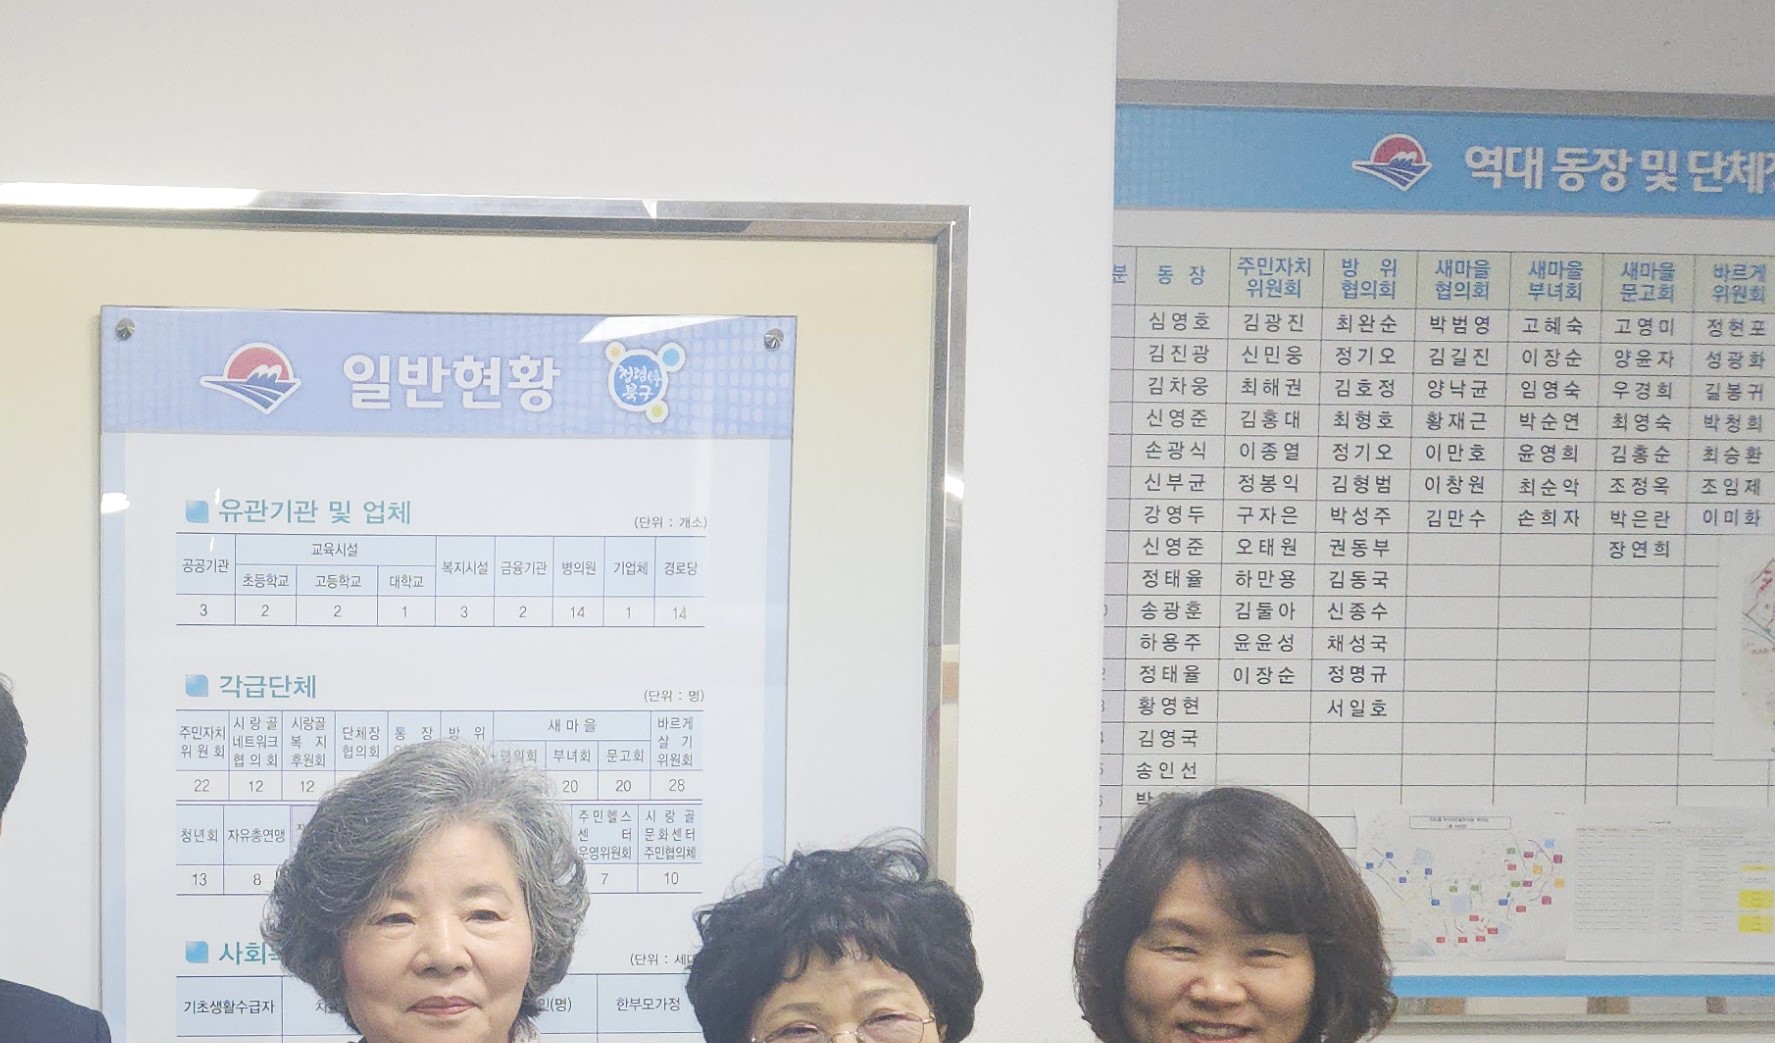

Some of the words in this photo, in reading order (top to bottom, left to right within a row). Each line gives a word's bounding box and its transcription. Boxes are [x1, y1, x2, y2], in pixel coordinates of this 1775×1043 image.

[1464, 145, 1543, 190] 역대
[1551, 147, 1633, 192] 동장
[1640, 149, 1678, 192] 및
[1688, 150, 1775, 194] 단체
[1237, 256, 1312, 277] 주민자치
[1434, 259, 1491, 279] 새마을
[1527, 260, 1584, 280] 새마을
[1620, 261, 1675, 282] 새마을
[1713, 263, 1767, 283] 바르게
[1246, 279, 1302, 299] 위원회
[1341, 280, 1397, 300] 협의회
[1434, 280, 1490, 301] 협의회
[1528, 281, 1583, 301] 부녀회
[1620, 283, 1675, 303] 문고회
[1712, 284, 1767, 304] 위원회
[342, 354, 562, 412] 일반현황
[218, 499, 319, 525] 유관기관
[328, 499, 352, 525] 및
[363, 499, 412, 525] 업체
[312, 542, 359, 557] 교육시설
[182, 558, 230, 574] 공공기관
[441, 560, 489, 576] 복지시설
[500, 560, 548, 576] 금융기관
[561, 560, 597, 576] 병의원
[613, 561, 649, 576] 기업체
[664, 561, 699, 576] 경로당
[242, 573, 290, 588] 초등학교
[315, 573, 362, 589] 고등학교
[389, 575, 425, 589] 대학교
[570, 606, 586, 619] 14
[219, 674, 317, 699] 각급단체
[657, 715, 695, 730] 바르게
[179, 725, 226, 741] 주민자치
[342, 726, 381, 741] 단체장
[232, 735, 279, 749] 네트워크
[342, 744, 381, 760] 협의회
[553, 748, 592, 763] 부녀회
[606, 748, 645, 763] 문고회
[291, 753, 327, 768] 후원회
[657, 752, 694, 768] 위원회
[194, 780, 210, 793] 22
[249, 780, 264, 793] 12
[562, 779, 579, 793] 20
[668, 778, 686, 792] 28
[180, 828, 219, 843] 청년회
[227, 828, 286, 843] 자유총연맹
[644, 827, 696, 842] 문화센터
[192, 873, 207, 886] 13
[664, 872, 679, 885] 10
[184, 1000, 275, 1015] 기초생활수급자
[616, 997, 681, 1011] 한부모가정
